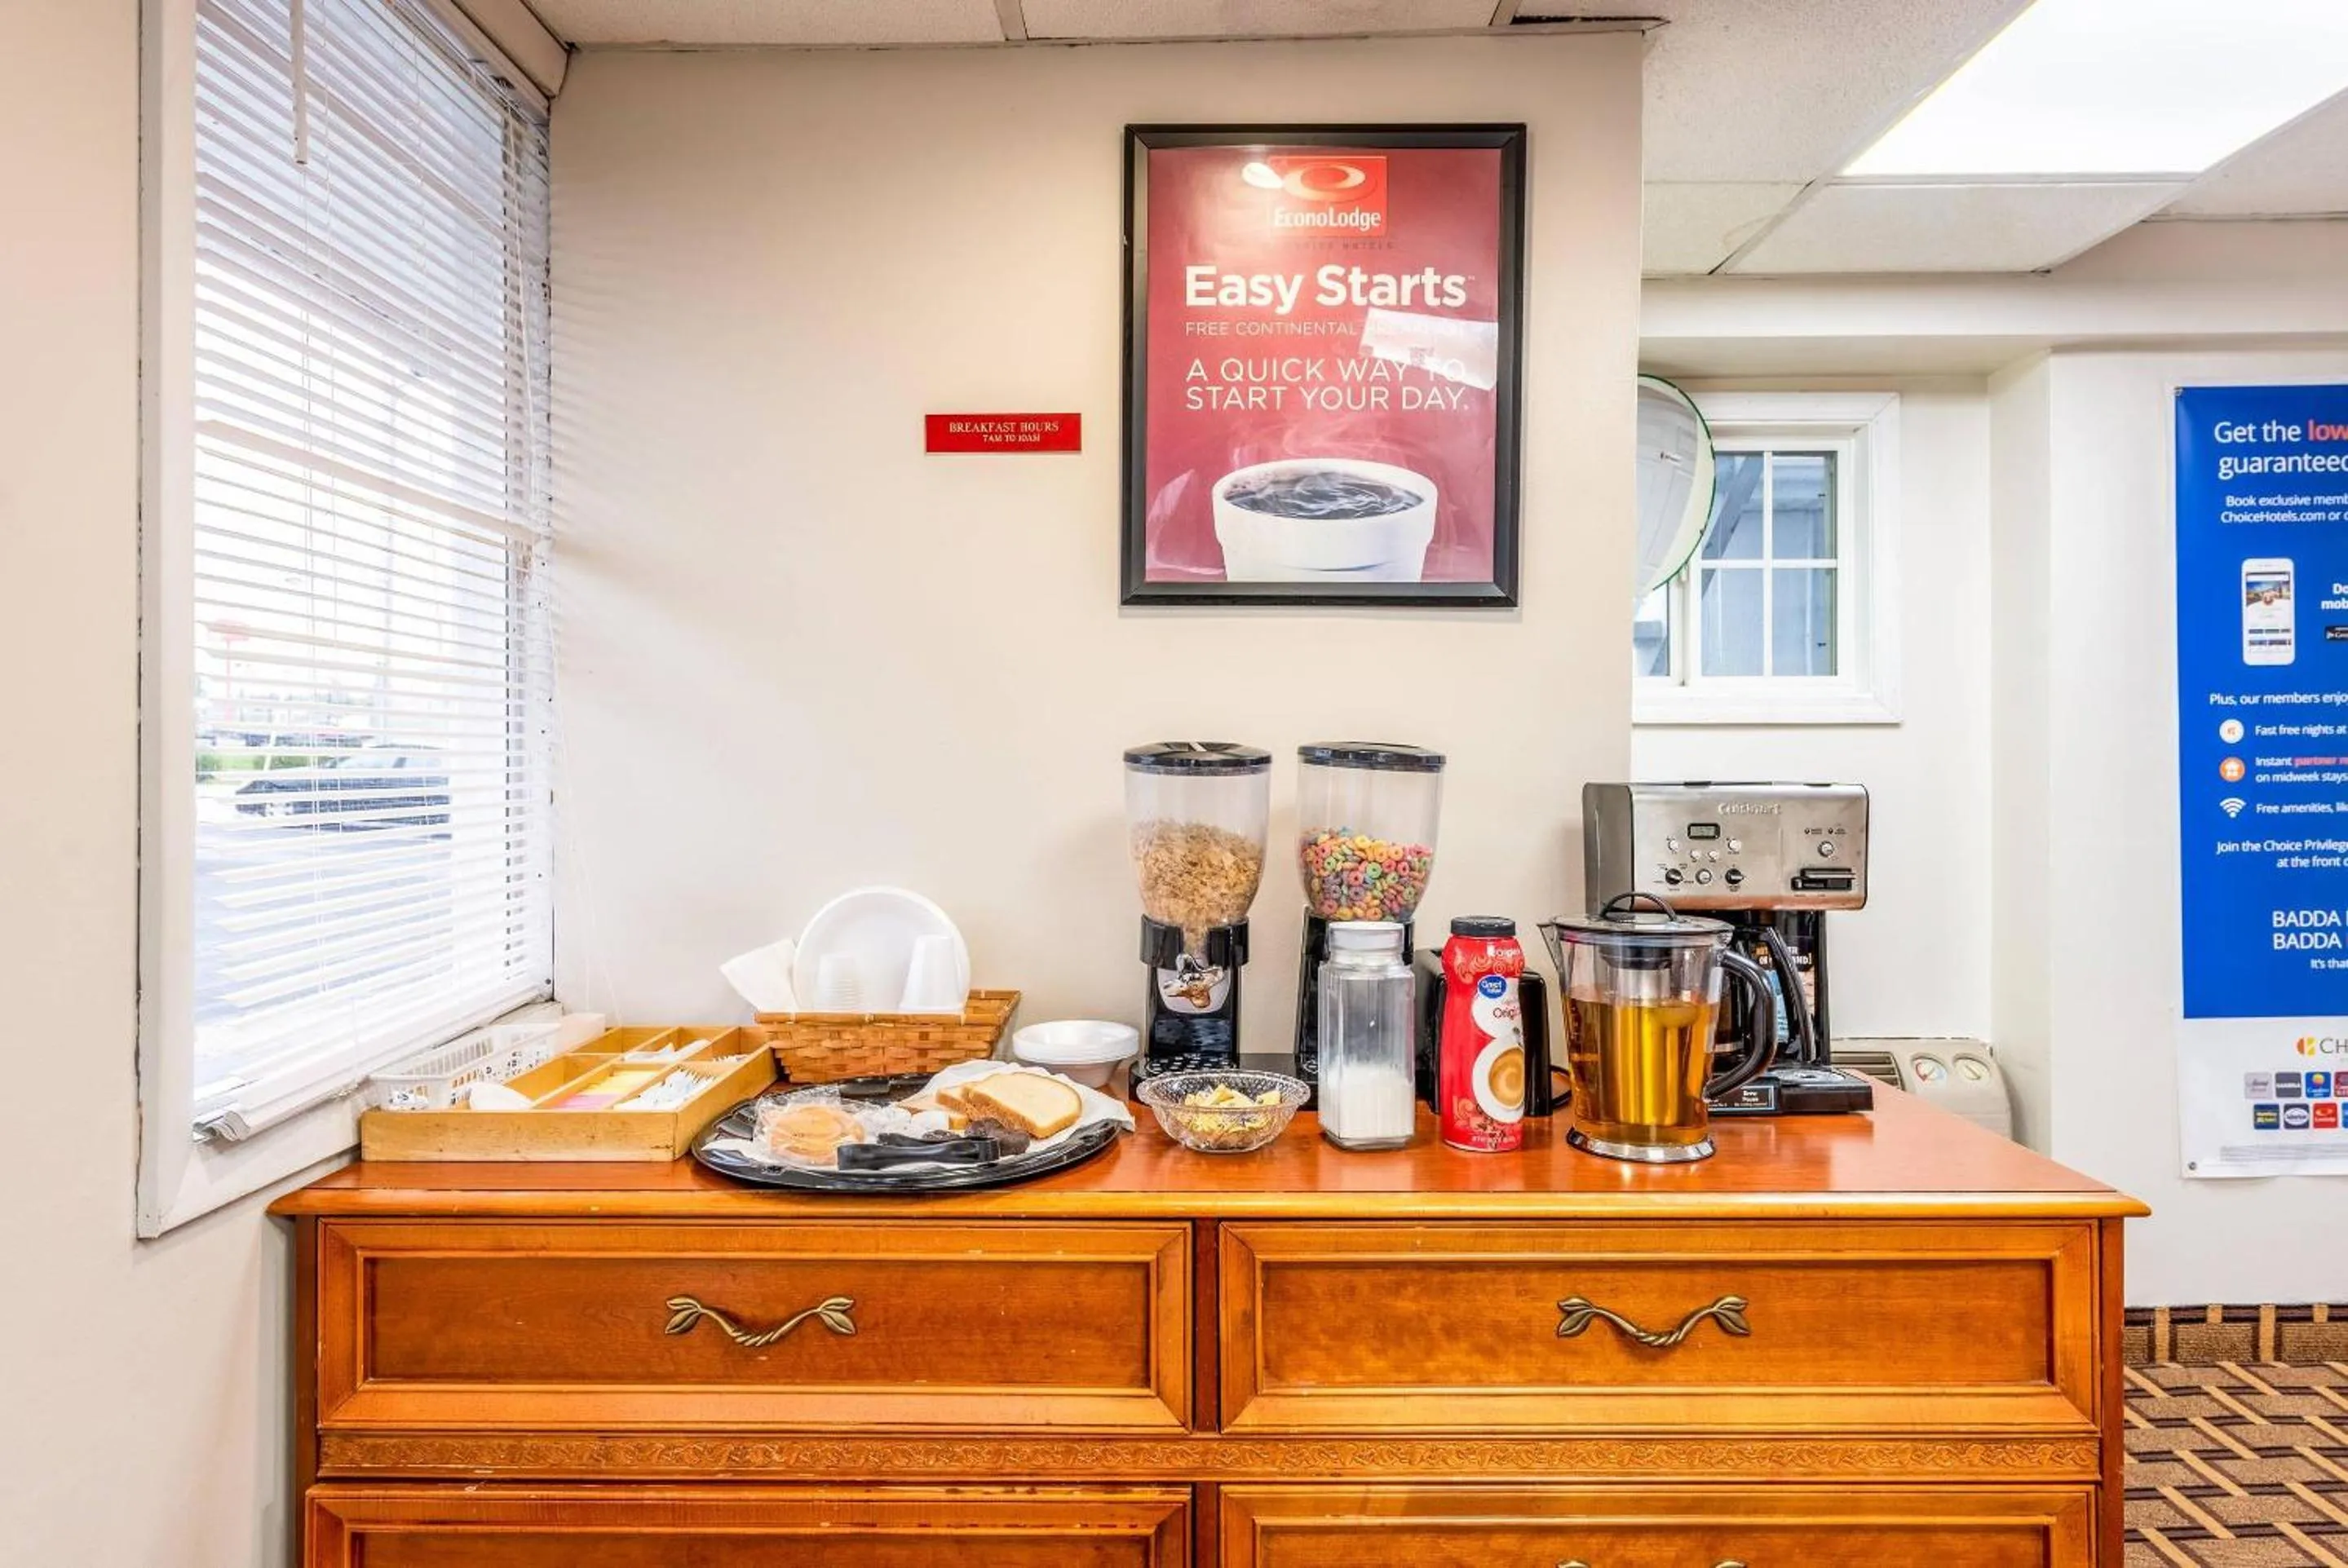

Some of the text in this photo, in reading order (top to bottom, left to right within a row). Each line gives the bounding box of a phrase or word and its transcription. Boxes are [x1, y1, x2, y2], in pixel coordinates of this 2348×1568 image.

[1274, 205, 1382, 232] EconoLodge
[1185, 263, 1467, 315] Easy Starts
[1185, 321, 1230, 337] FREE
[1236, 320, 1357, 337] CONTINENTAL
[1185, 358, 1209, 382] A
[1220, 357, 1326, 382] QUICK
[1337, 358, 1408, 382] WAY
[1186, 386, 1470, 411] START YOUR DAY.
[948, 421, 1059, 433] BREAKFAST HOURS
[2213, 420, 2257, 444] Get
[2262, 418, 2302, 443] the
[983, 434, 1003, 442] 7AM
[2225, 495, 2256, 507] Book
[2258, 494, 2311, 506] exclusive
[2220, 510, 2326, 523] ChoiceHotels.com
[2328, 511, 2342, 521] or
[2209, 691, 2348, 707] Plus, our members enjo
[2255, 723, 2347, 737] Fast free nights at
[2255, 757, 2293, 766] Instant
[2255, 774, 2271, 783] on
[2272, 771, 2319, 782] midweek
[2256, 804, 2279, 814] Free
[2281, 802, 2334, 814] amenities,
[2217, 838, 2348, 855] Join the Choice Privileg
[2276, 857, 2288, 868] at
[2290, 856, 2310, 868] the
[2311, 855, 2341, 867] front
[2272, 910, 2342, 928] BADDA
[2273, 932, 2343, 950] BADDA
